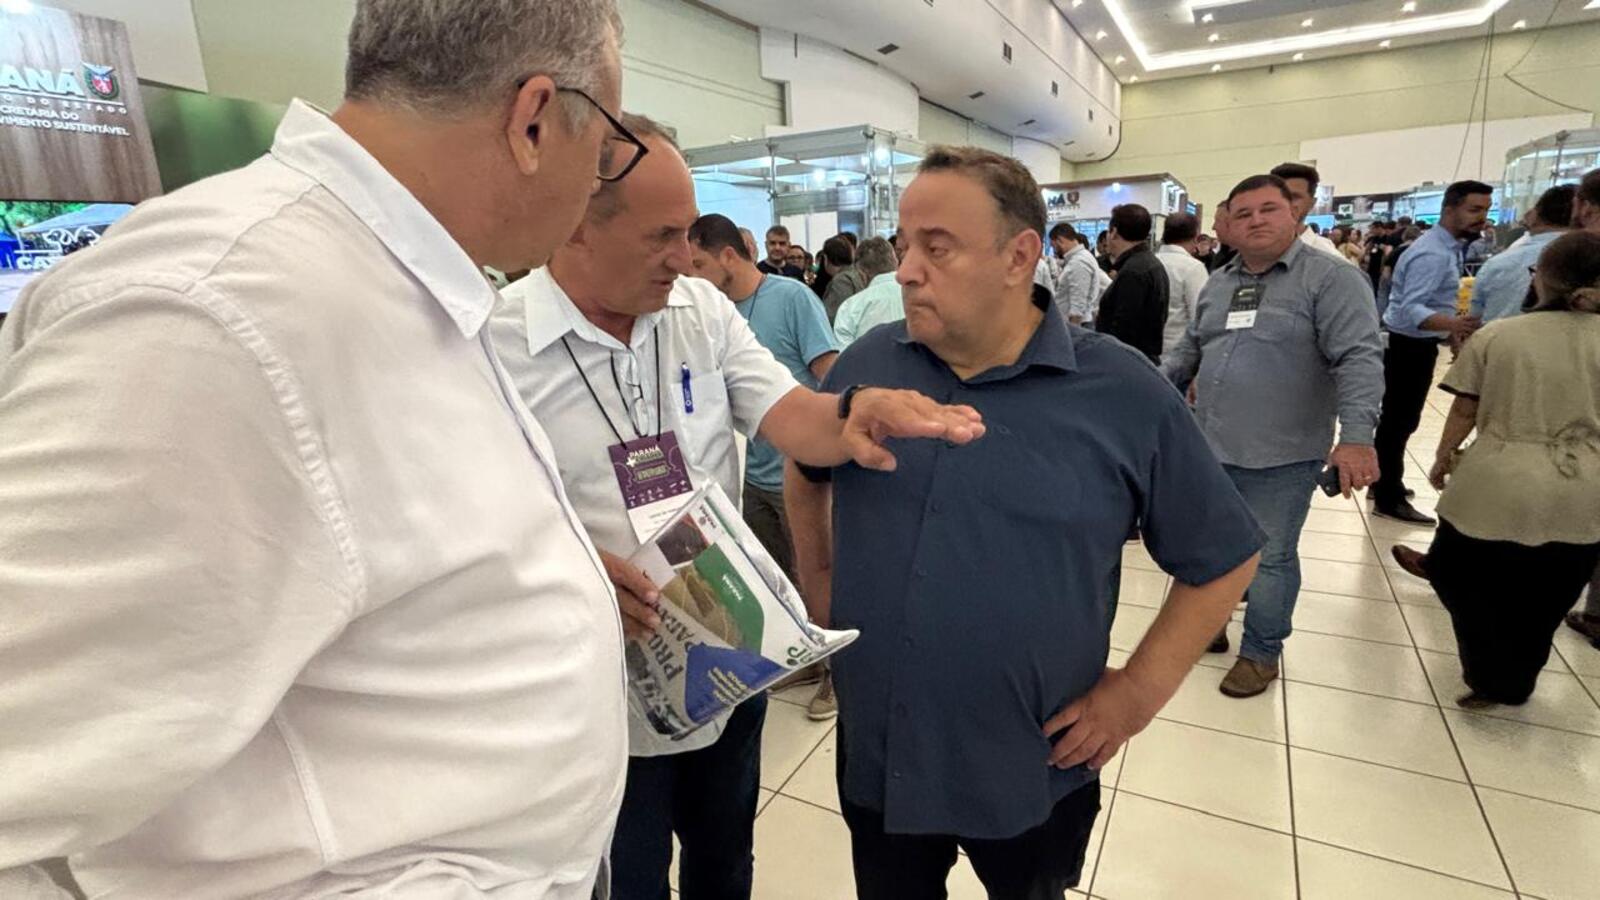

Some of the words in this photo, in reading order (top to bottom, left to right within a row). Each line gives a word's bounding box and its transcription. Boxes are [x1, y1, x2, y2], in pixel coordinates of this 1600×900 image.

[62, 100, 127, 114] ESTADO
[60, 110, 79, 120] DO
[52, 119, 130, 135] SUSTENTÁVEL
